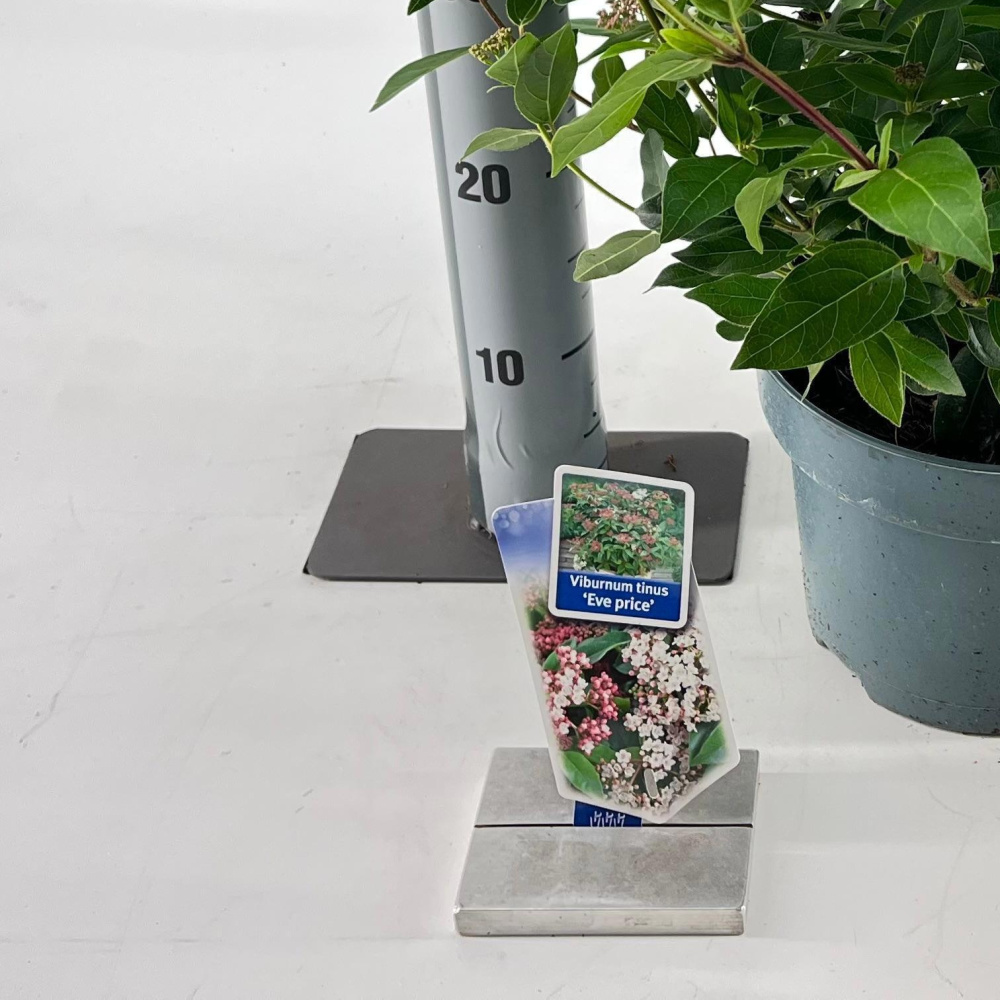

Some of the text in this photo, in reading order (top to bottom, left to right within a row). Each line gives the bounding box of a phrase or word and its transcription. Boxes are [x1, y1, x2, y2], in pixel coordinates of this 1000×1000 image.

[455, 161, 511, 205] 20
[475, 347, 525, 387] 10
[570, 574, 669, 597] Viburnum tinus
